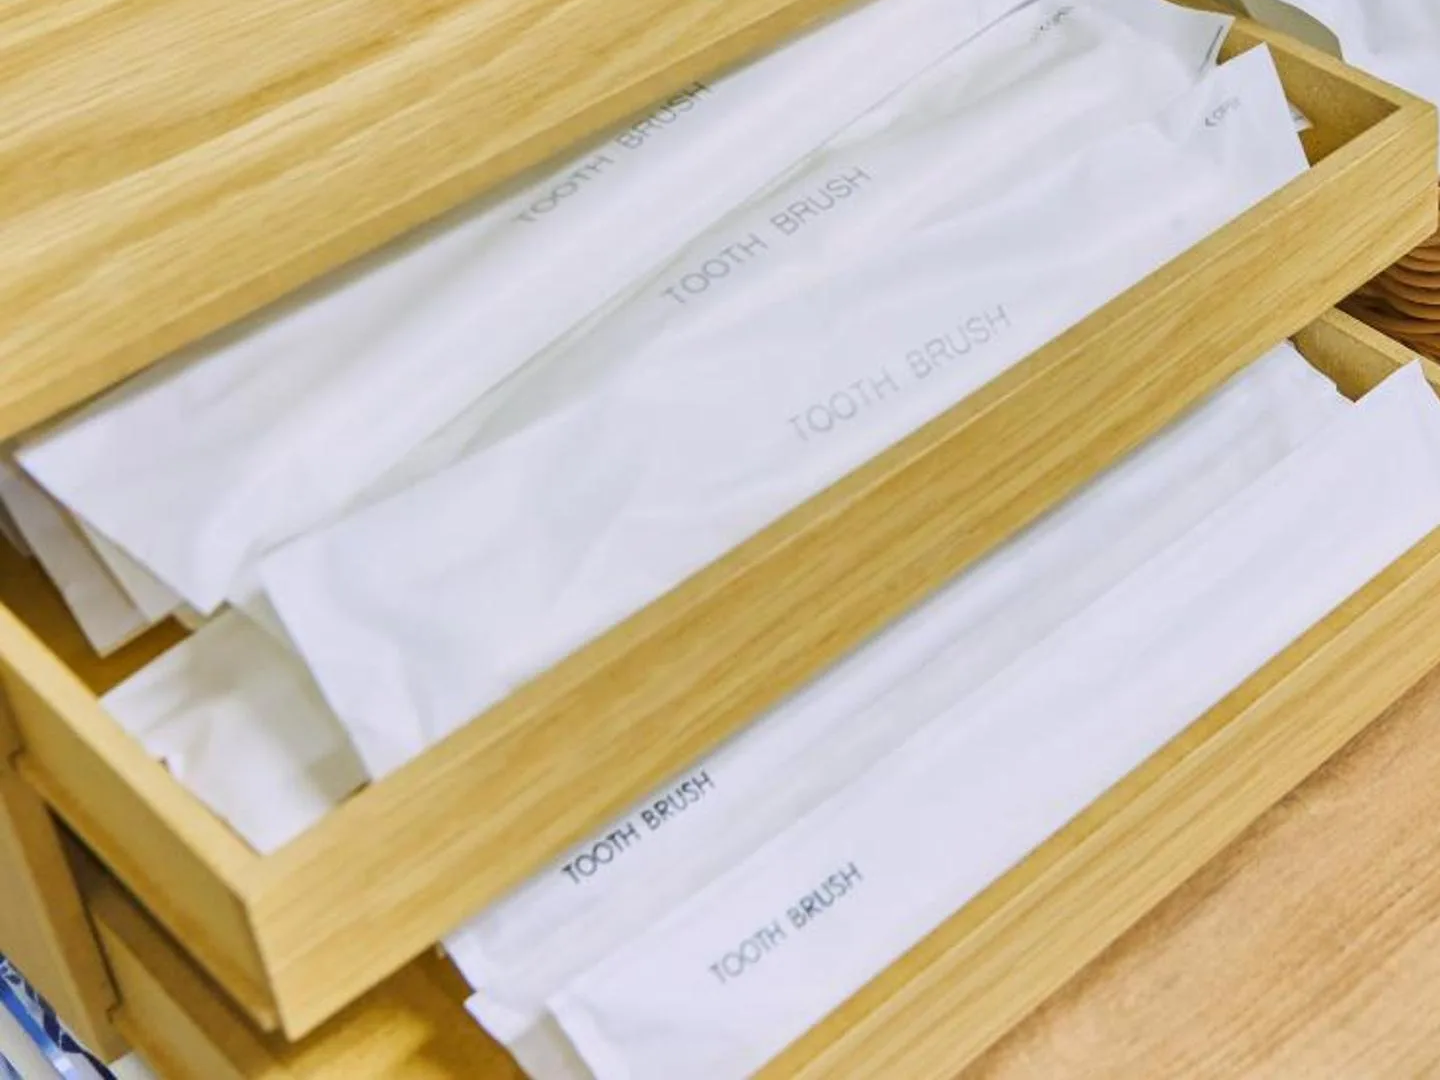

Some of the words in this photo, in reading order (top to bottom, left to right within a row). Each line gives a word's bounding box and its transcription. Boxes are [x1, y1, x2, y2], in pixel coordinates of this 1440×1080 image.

[514, 155, 615, 226] TOOTH
[615, 80, 714, 151] BRUSH
[661, 231, 769, 306] TOOTH
[769, 166, 872, 236] BRUSH
[786, 366, 900, 443] TOOTH
[905, 304, 1013, 380] BRUSH
[561, 823, 641, 885] TOOTH
[641, 770, 716, 832] BRUSH
[709, 920, 787, 985] TOOTH
[786, 861, 864, 930] BRUSH
